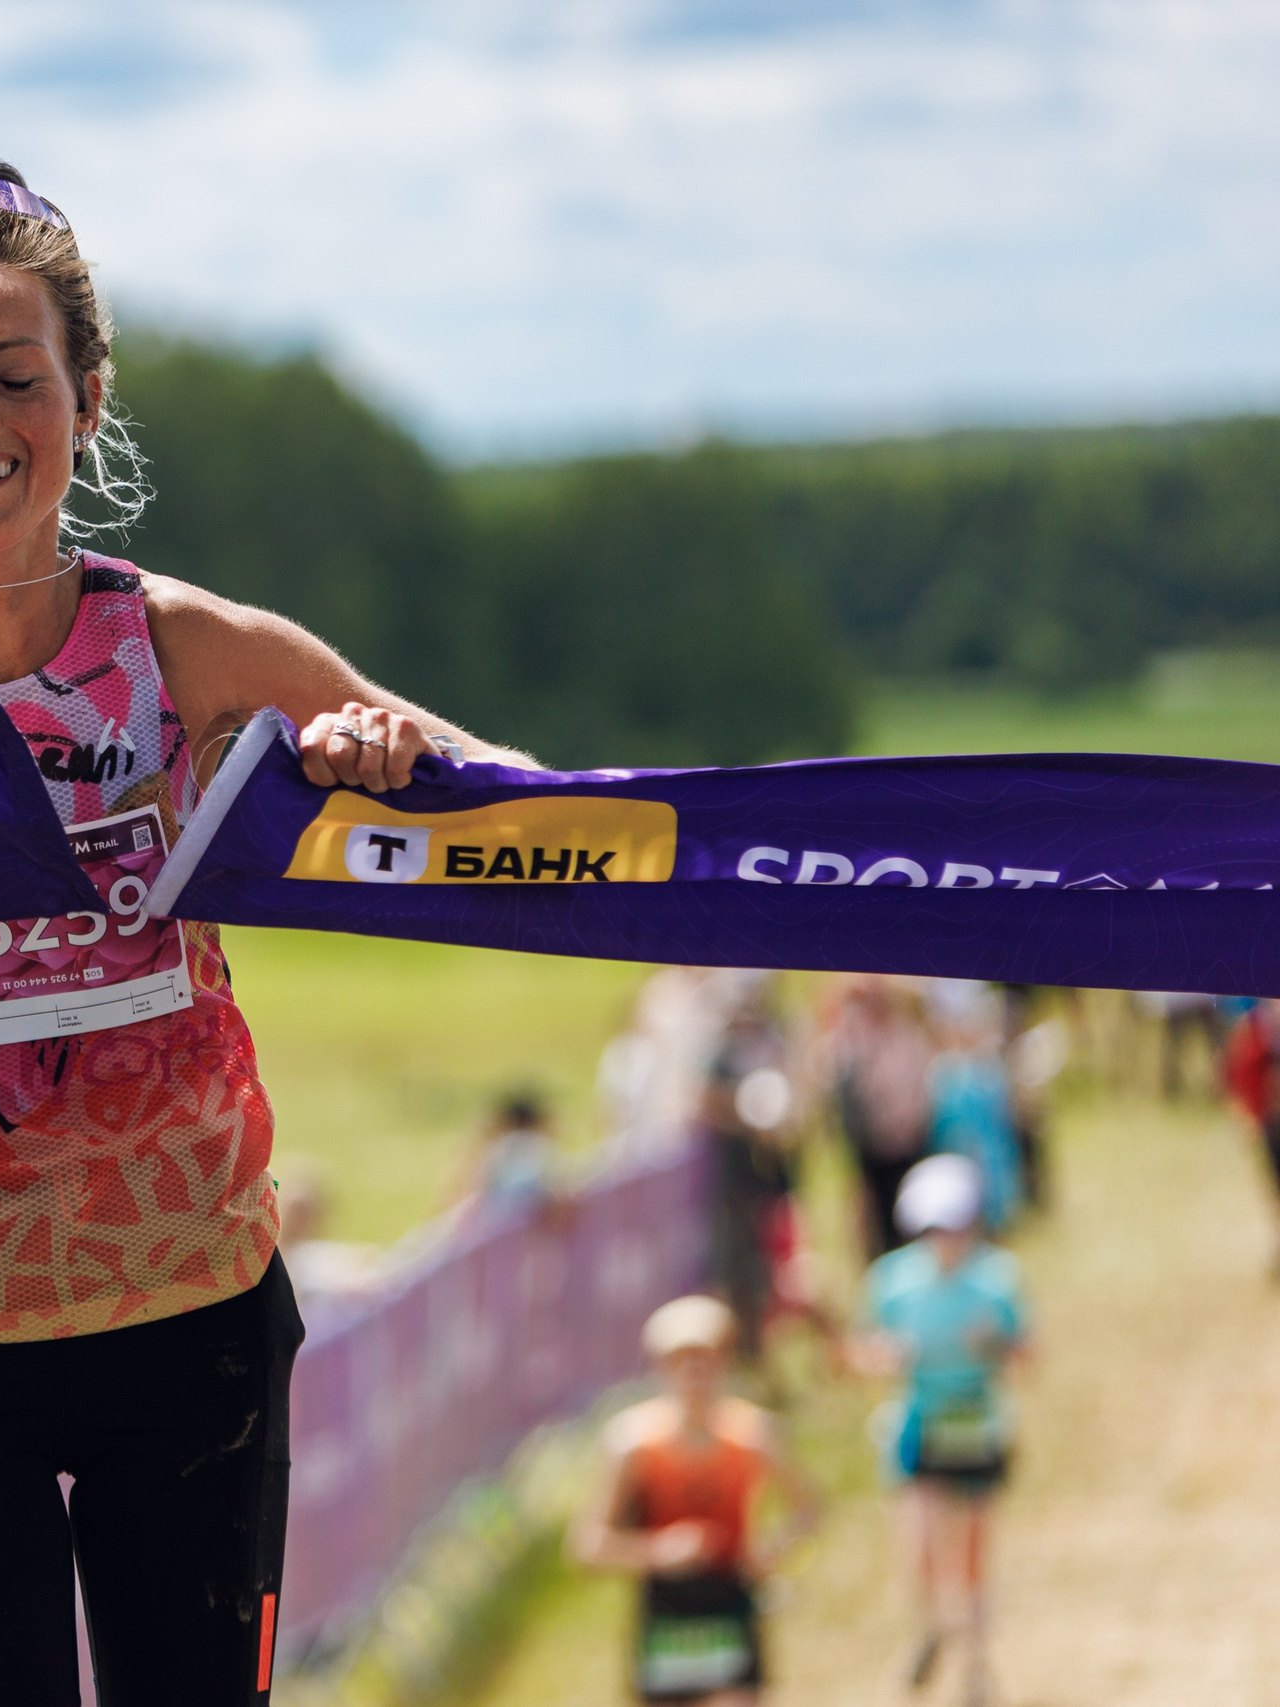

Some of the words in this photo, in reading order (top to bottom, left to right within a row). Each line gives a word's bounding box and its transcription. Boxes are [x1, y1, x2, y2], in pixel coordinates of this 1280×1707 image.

[93, 838, 119, 850] TRAIL
[444, 845, 618, 882] БАНК
[69, 973, 80, 981] +7
[85, 969, 102, 978] SOS
[29, 976, 48, 986] 444
[50, 974, 67, 983] 925
[2, 981, 11, 990] 11
[13, 979, 27, 989] 00
